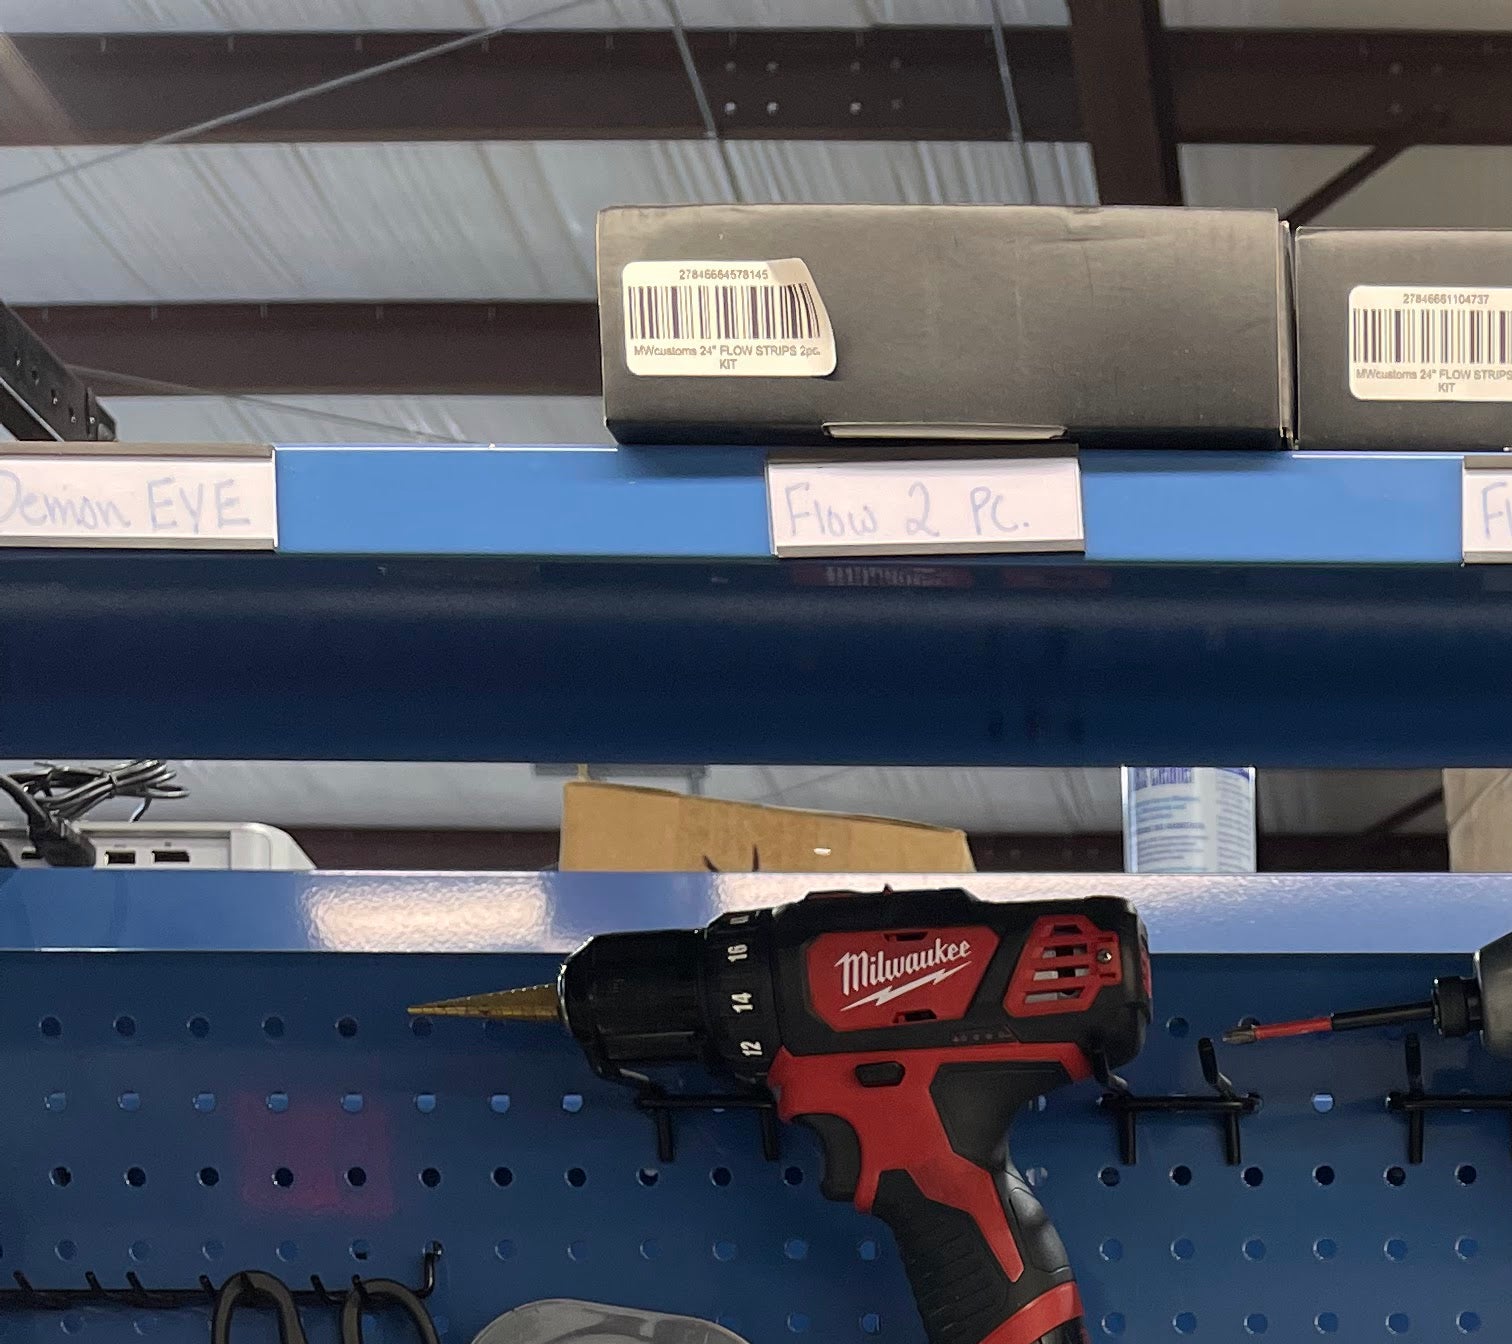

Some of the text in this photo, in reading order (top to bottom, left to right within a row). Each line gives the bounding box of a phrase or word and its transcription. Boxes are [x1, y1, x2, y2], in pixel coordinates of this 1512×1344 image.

[719, 345, 752, 356] FLOW
[755, 345, 797, 356] STRIPS
[719, 359, 738, 370] KIT
[1439, 369, 1471, 380] FLOW
[1438, 383, 1456, 393] KIT
[147, 477, 251, 535] EYE
[784, 481, 879, 537] Flow
[906, 480, 940, 538] 2
[727, 944, 748, 963] 16
[834, 937, 973, 997] Milwaukee
[731, 991, 754, 1014] 14
[740, 1040, 763, 1057] 12
